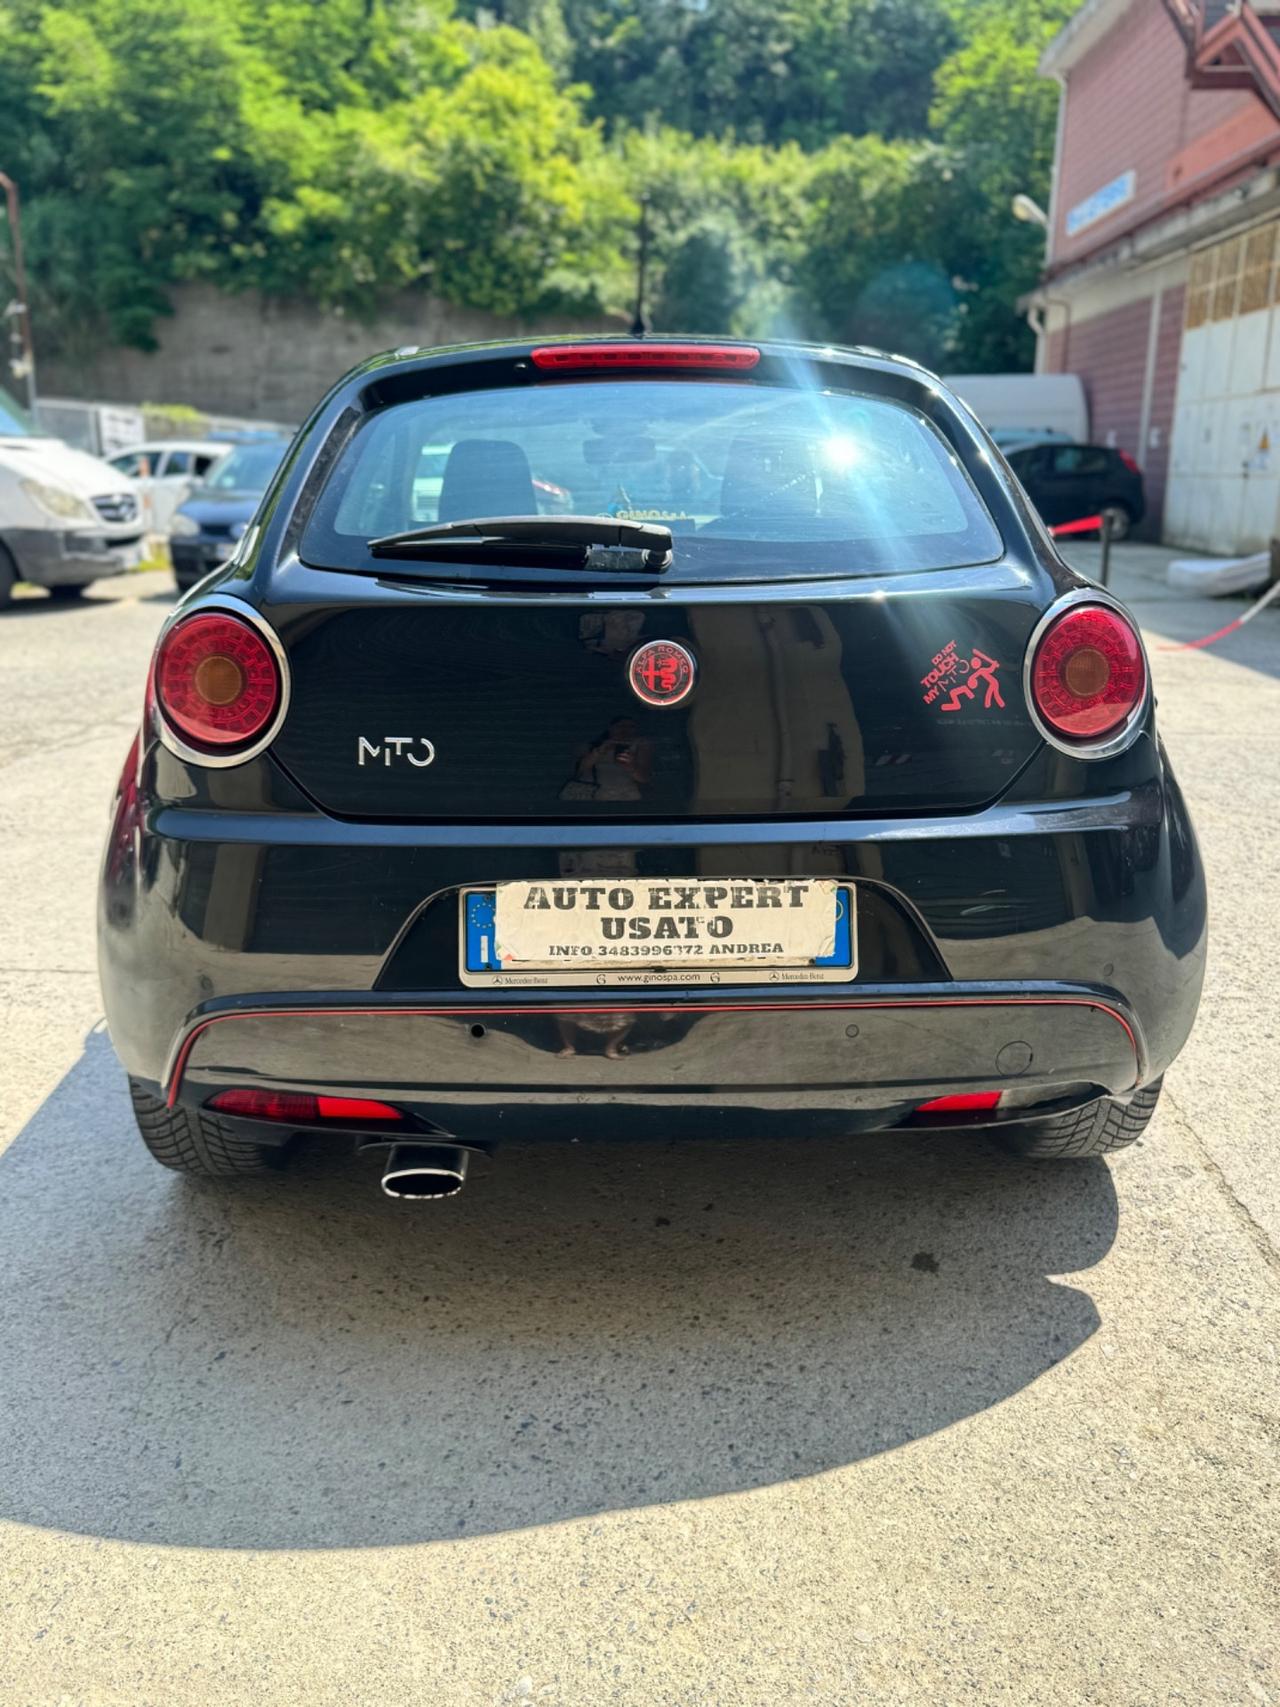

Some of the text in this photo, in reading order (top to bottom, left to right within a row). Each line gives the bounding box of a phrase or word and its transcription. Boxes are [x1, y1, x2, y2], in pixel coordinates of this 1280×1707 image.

[920, 652, 960, 688] TOUCH
[923, 685, 939, 704] MY
[523, 885, 809, 910] AUTO EXPERT
[600, 915, 733, 940] USATO
[549, 945, 593, 956] INFO
[709, 942, 784, 955] ANDREA
[617, 973, 701, 984] www.ginospa.com
